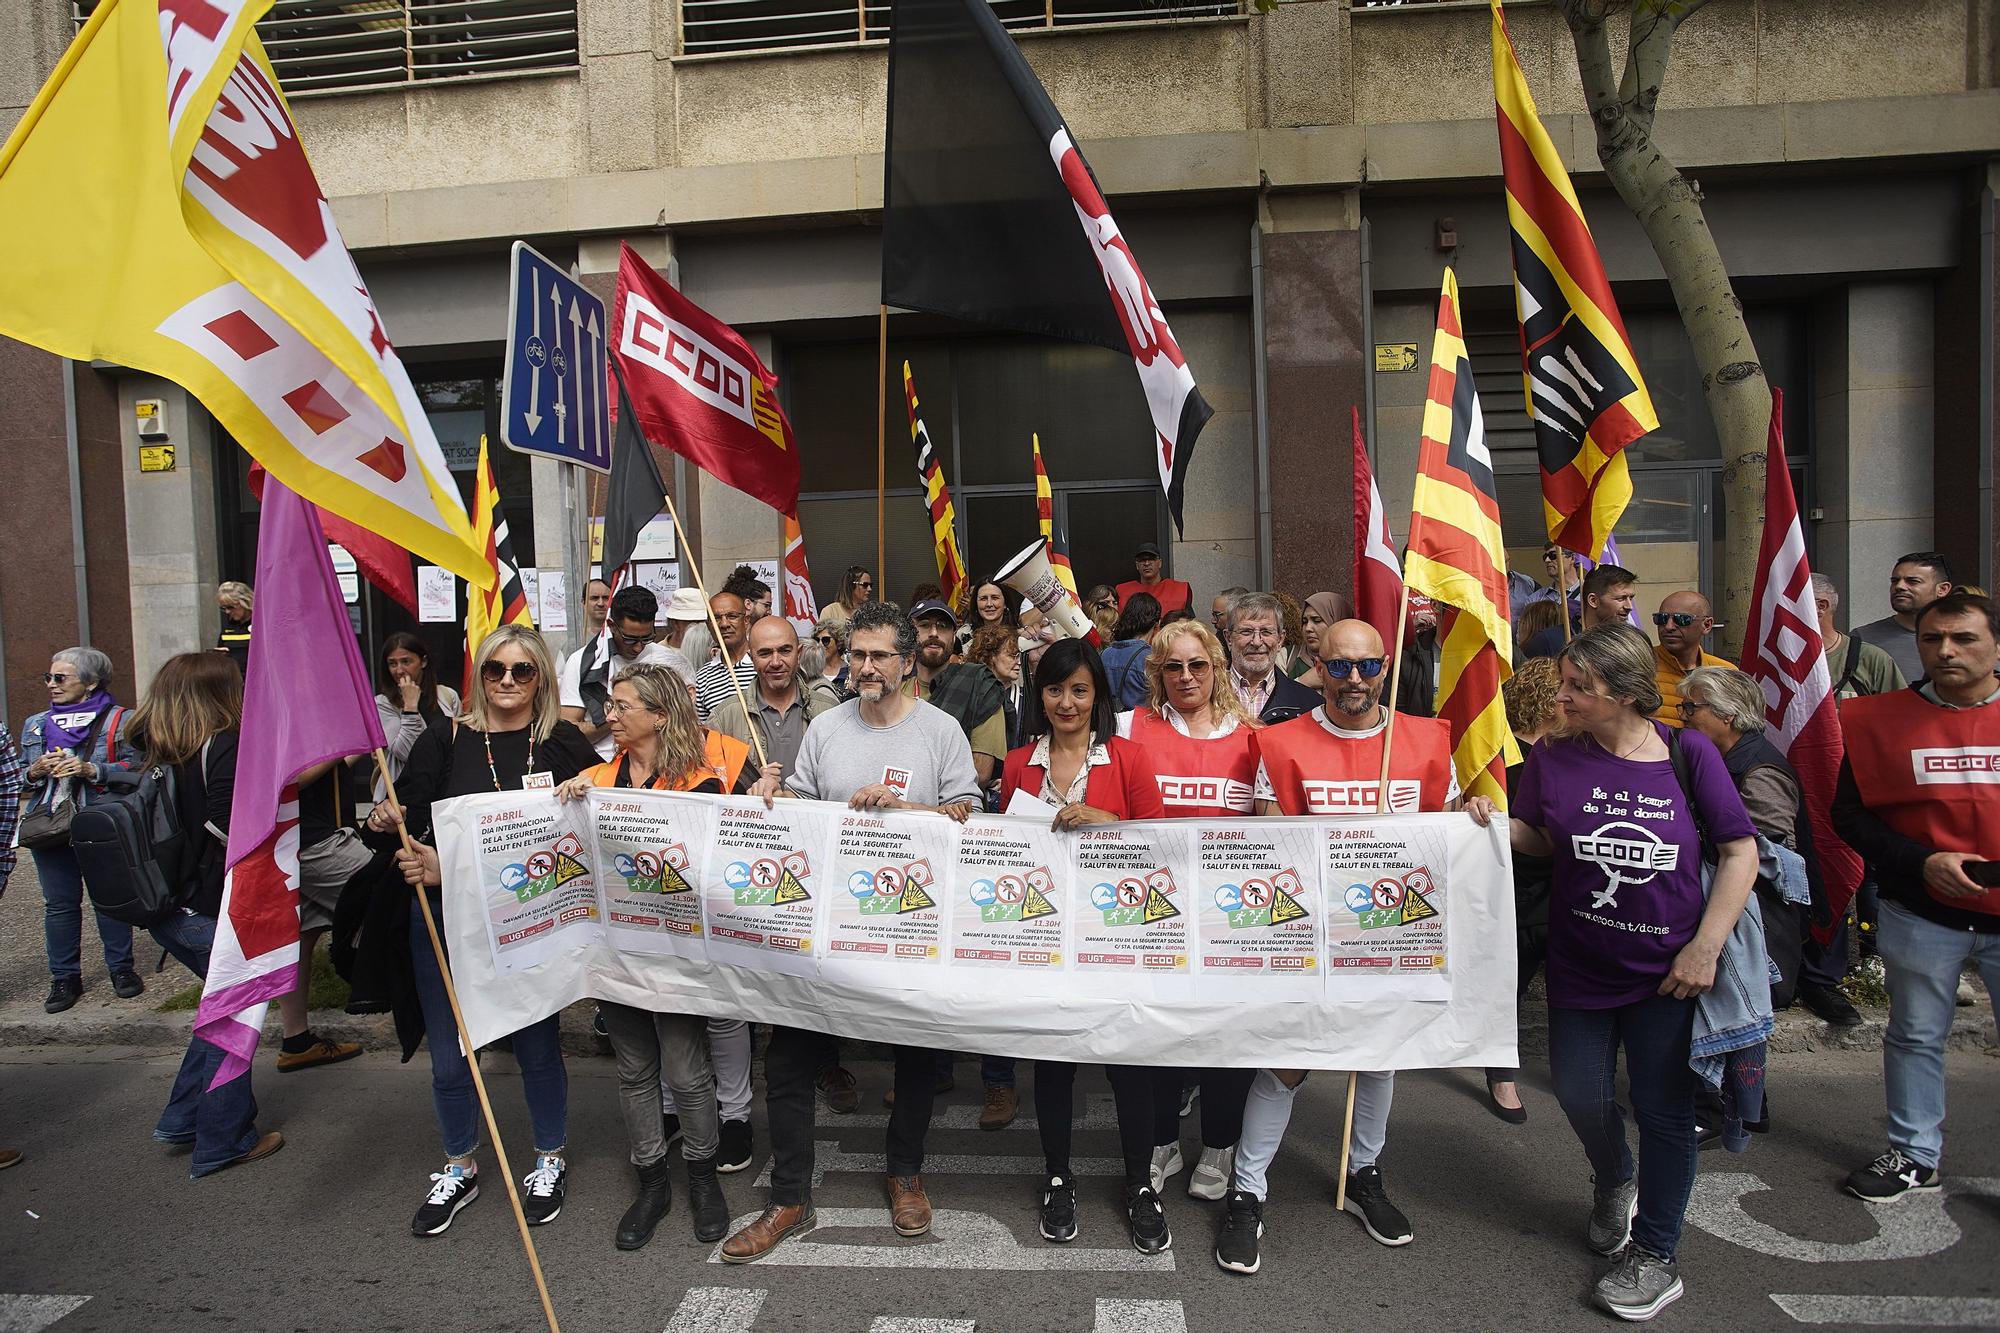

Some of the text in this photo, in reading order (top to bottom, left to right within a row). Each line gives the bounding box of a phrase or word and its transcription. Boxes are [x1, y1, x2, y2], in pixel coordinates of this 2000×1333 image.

[632, 310, 744, 408] CCOO
[1928, 758, 1986, 769] CCOO
[530, 776, 550, 787] UGT
[889, 771, 908, 783] UGT
[1160, 782, 1216, 800] COO
[1615, 791, 1630, 802] el
[599, 802, 643, 813] 28 ABRIL
[1583, 803, 1674, 821] de les dones!
[481, 810, 523, 824] 28 ABRIL
[721, 808, 764, 820] 28 ABRIL
[496, 815, 555, 832] INTERNACIONAL
[612, 815, 670, 826] INTERNACIONAL
[842, 817, 885, 829] 28 ABRIL
[620, 825, 660, 834] SEGURETAT
[734, 820, 791, 833] INTERNACIONAL
[506, 826, 548, 840] SEGURETAT
[603, 833, 623, 841] SALUT
[742, 831, 781, 841] SEGURETAT
[855, 830, 912, 841] INTERNACIONAL
[962, 828, 1004, 838] 28 ABRIL
[1080, 832, 1123, 841] 28 ABRIL
[1202, 831, 1246, 841] 28 ABRIL
[1329, 830, 1375, 839] 28 ABRIL
[488, 844, 511, 853] SALUT
[534, 831, 562, 844] TREBALL
[722, 839, 744, 847] SALUT
[766, 843, 794, 851] TREBALL
[863, 840, 903, 849] SEGURETAT
[975, 839, 1031, 849] INTERNACIONAL
[1094, 843, 1150, 851] INTERNACIONAL
[1217, 843, 1275, 851] INTERNACIONAL
[984, 849, 1022, 858] SEGURETAT
[1578, 841, 1645, 862] CCOO
[568, 880, 593, 888] 11.30H
[672, 894, 697, 903] 11.30H
[561, 909, 587, 920] CCOO
[786, 905, 813, 914] 11.30H
[912, 912, 938, 921] 11.30H
[667, 920, 690, 930] CCOO
[1034, 920, 1060, 928] 11.30H
[1157, 922, 1184, 930] 11.30H
[772, 937, 798, 946] CCOO
[840, 942, 867, 951] UGT.cat
[897, 946, 925, 954] CCOO
[964, 950, 990, 958] UGT.cat
[1020, 953, 1048, 961] CCOO
[1088, 955, 1114, 963] UGT.cat
[1145, 956, 1173, 964] CCOO
[1214, 958, 1241, 966] UGT.cat
